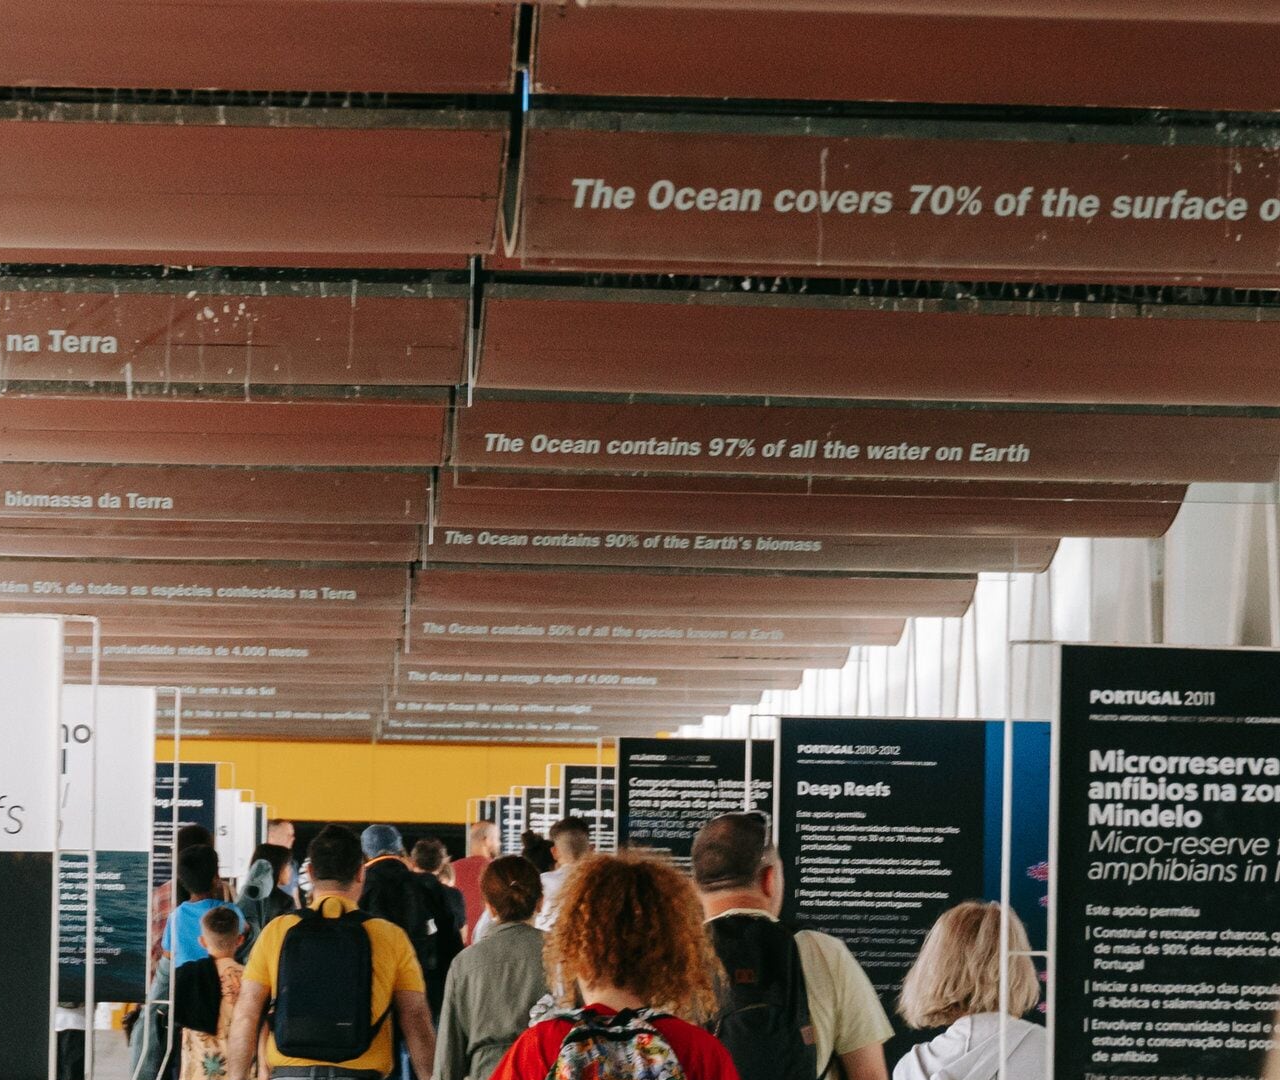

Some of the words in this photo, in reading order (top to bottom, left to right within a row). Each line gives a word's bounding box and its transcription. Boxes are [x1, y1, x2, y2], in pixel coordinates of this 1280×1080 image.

[572, 176, 635, 209] The
[648, 178, 761, 211] Ocean
[774, 188, 892, 214] covers
[910, 183, 981, 215] 70%
[993, 184, 1033, 216] of
[1041, 185, 1099, 218] the
[1112, 186, 1246, 220] surface
[6, 333, 40, 352] na
[47, 328, 117, 353] Terra
[485, 432, 523, 452] The
[530, 433, 600, 454] Ocean
[606, 434, 700, 456] contains
[708, 436, 755, 457] 97%
[761, 437, 786, 458] of
[788, 438, 817, 458] all
[823, 439, 859, 459] the
[866, 440, 930, 460] water
[934, 446, 963, 461] on
[969, 442, 1029, 462] Earth
[4, 489, 92, 507] biomassa
[97, 491, 121, 508] da
[126, 492, 173, 509] Terra
[444, 530, 473, 546] The
[477, 531, 528, 547] Ocean
[531, 531, 600, 548] contains
[604, 532, 639, 549] 90%
[642, 533, 661, 549] of
[663, 533, 690, 550] the
[693, 534, 751, 551] Earth's
[755, 535, 821, 552] biomass
[1089, 690, 1181, 706] PORTUGAL
[1183, 690, 1215, 706] 2011
[797, 744, 854, 755] PORTUGAL
[1089, 750, 1279, 775] Microrreserva
[796, 781, 841, 800] Deep
[843, 781, 890, 796] Reefs
[1088, 778, 1197, 802] anfíbios
[1202, 785, 1237, 802] na
[1088, 804, 1201, 828] Mindelo
[1089, 830, 1269, 856] Micro-reserve
[1088, 858, 1236, 888] amphibians
[1243, 860, 1267, 883] in
[1085, 904, 1111, 917] Este
[1111, 904, 1148, 920] apoio
[1149, 905, 1200, 921] permitiu
[1093, 958, 1144, 974] Portugal
